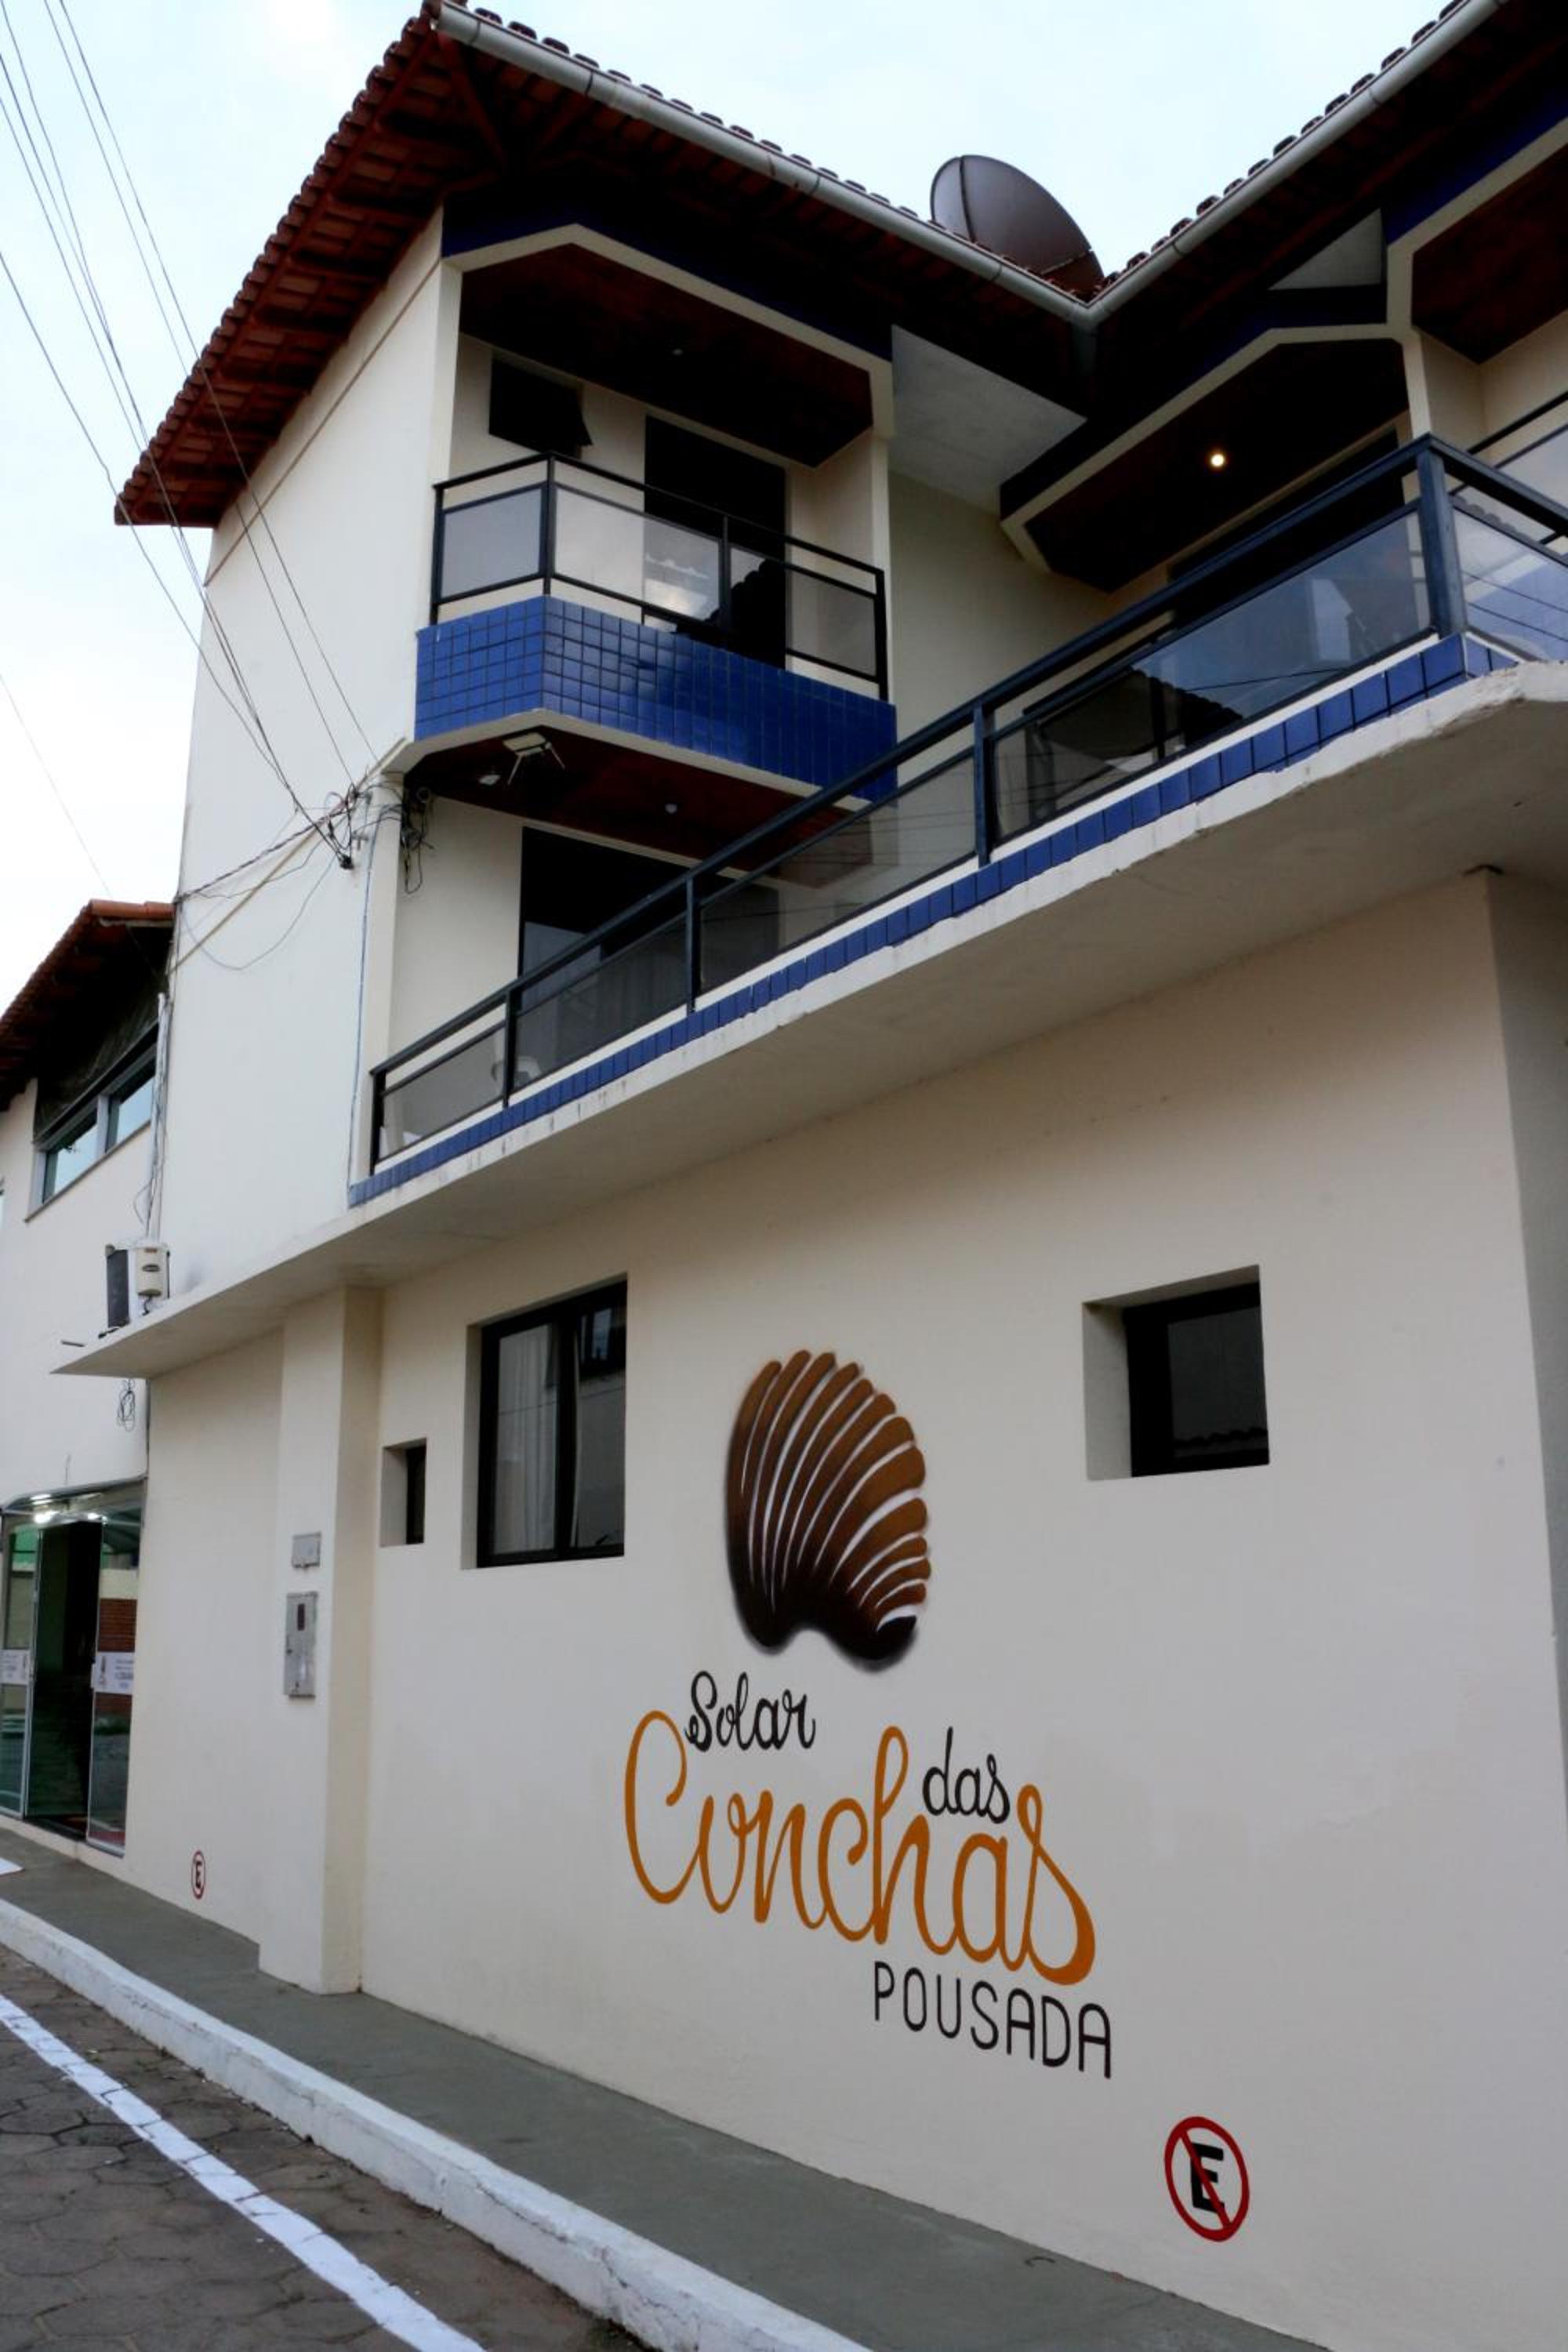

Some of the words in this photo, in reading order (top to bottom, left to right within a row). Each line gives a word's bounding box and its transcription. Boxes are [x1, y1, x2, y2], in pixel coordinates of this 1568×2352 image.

[684, 1671, 815, 1751] Solar
[923, 1726, 1011, 1824] das
[625, 1711, 1096, 1986] Conchas
[873, 1962, 1112, 2078] POUSADA
[1190, 2142, 1225, 2214] E
